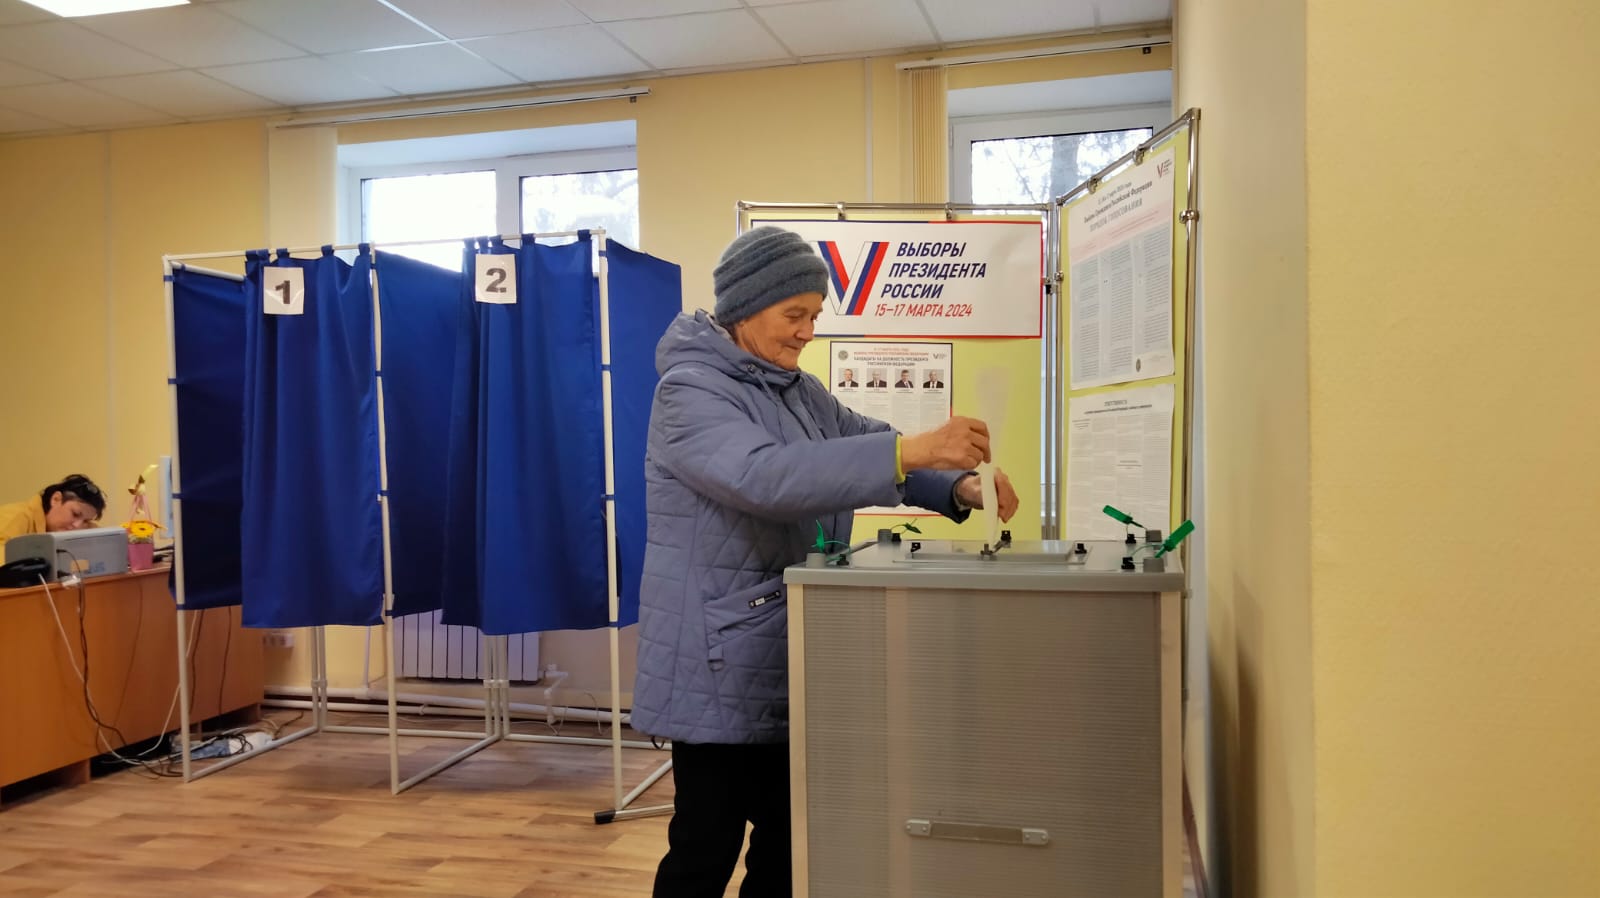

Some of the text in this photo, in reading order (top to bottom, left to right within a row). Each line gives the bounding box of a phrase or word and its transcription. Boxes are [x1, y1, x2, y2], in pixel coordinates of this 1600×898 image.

[896, 242, 966, 258] ВЫБОРЫ
[486, 268, 506, 293] 2
[888, 263, 987, 281] ПРЕЗИДЕНТА
[275, 280, 291, 305] 1
[880, 284, 944, 299] РОССИИ
[906, 304, 943, 317] МАРТА
[945, 304, 973, 317] 2024
